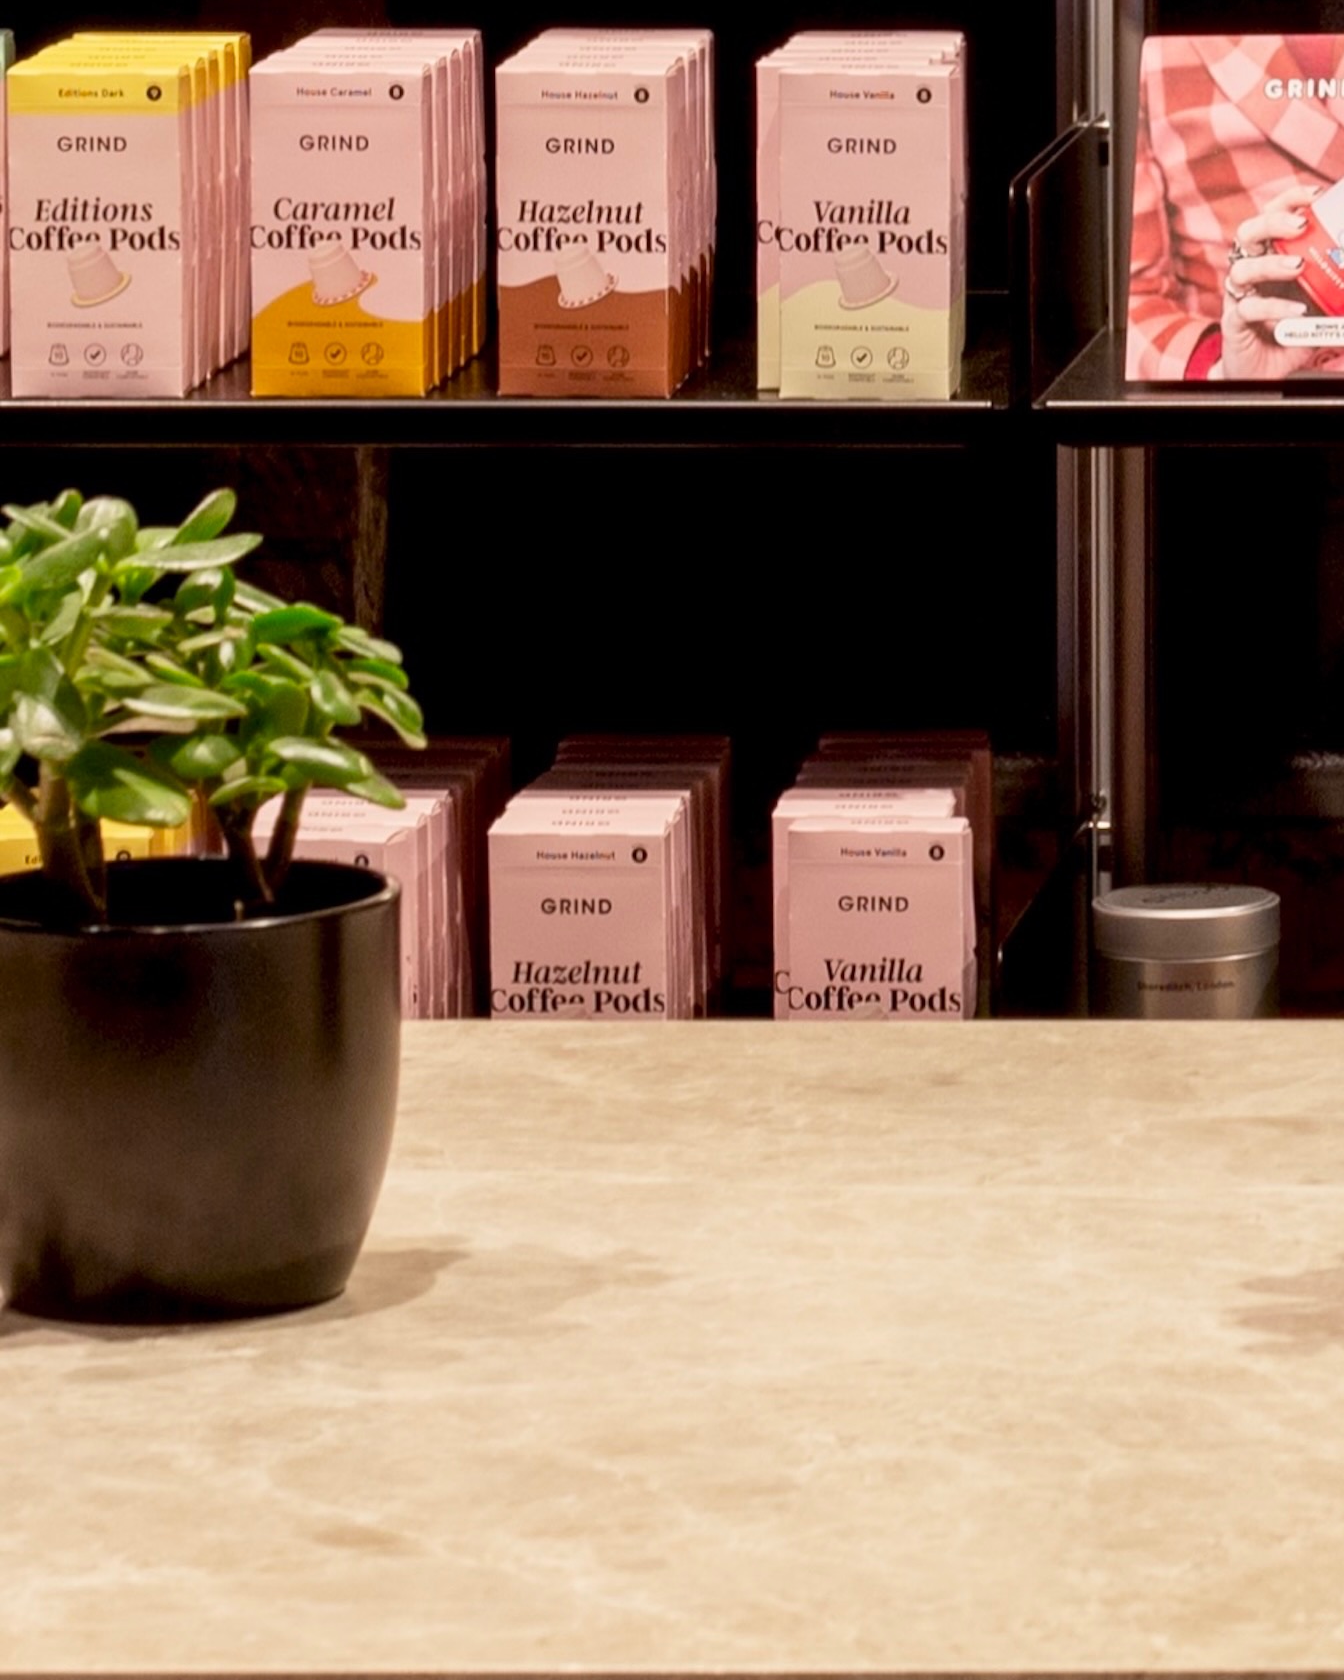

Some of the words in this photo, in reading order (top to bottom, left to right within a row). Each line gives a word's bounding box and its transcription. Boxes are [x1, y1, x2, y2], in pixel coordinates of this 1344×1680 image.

[56, 135, 128, 153] GRIND
[35, 196, 153, 223] Editions
[273, 196, 395, 222] Caramel
[518, 199, 643, 225] Hazelnut
[814, 199, 910, 225] Vanilla
